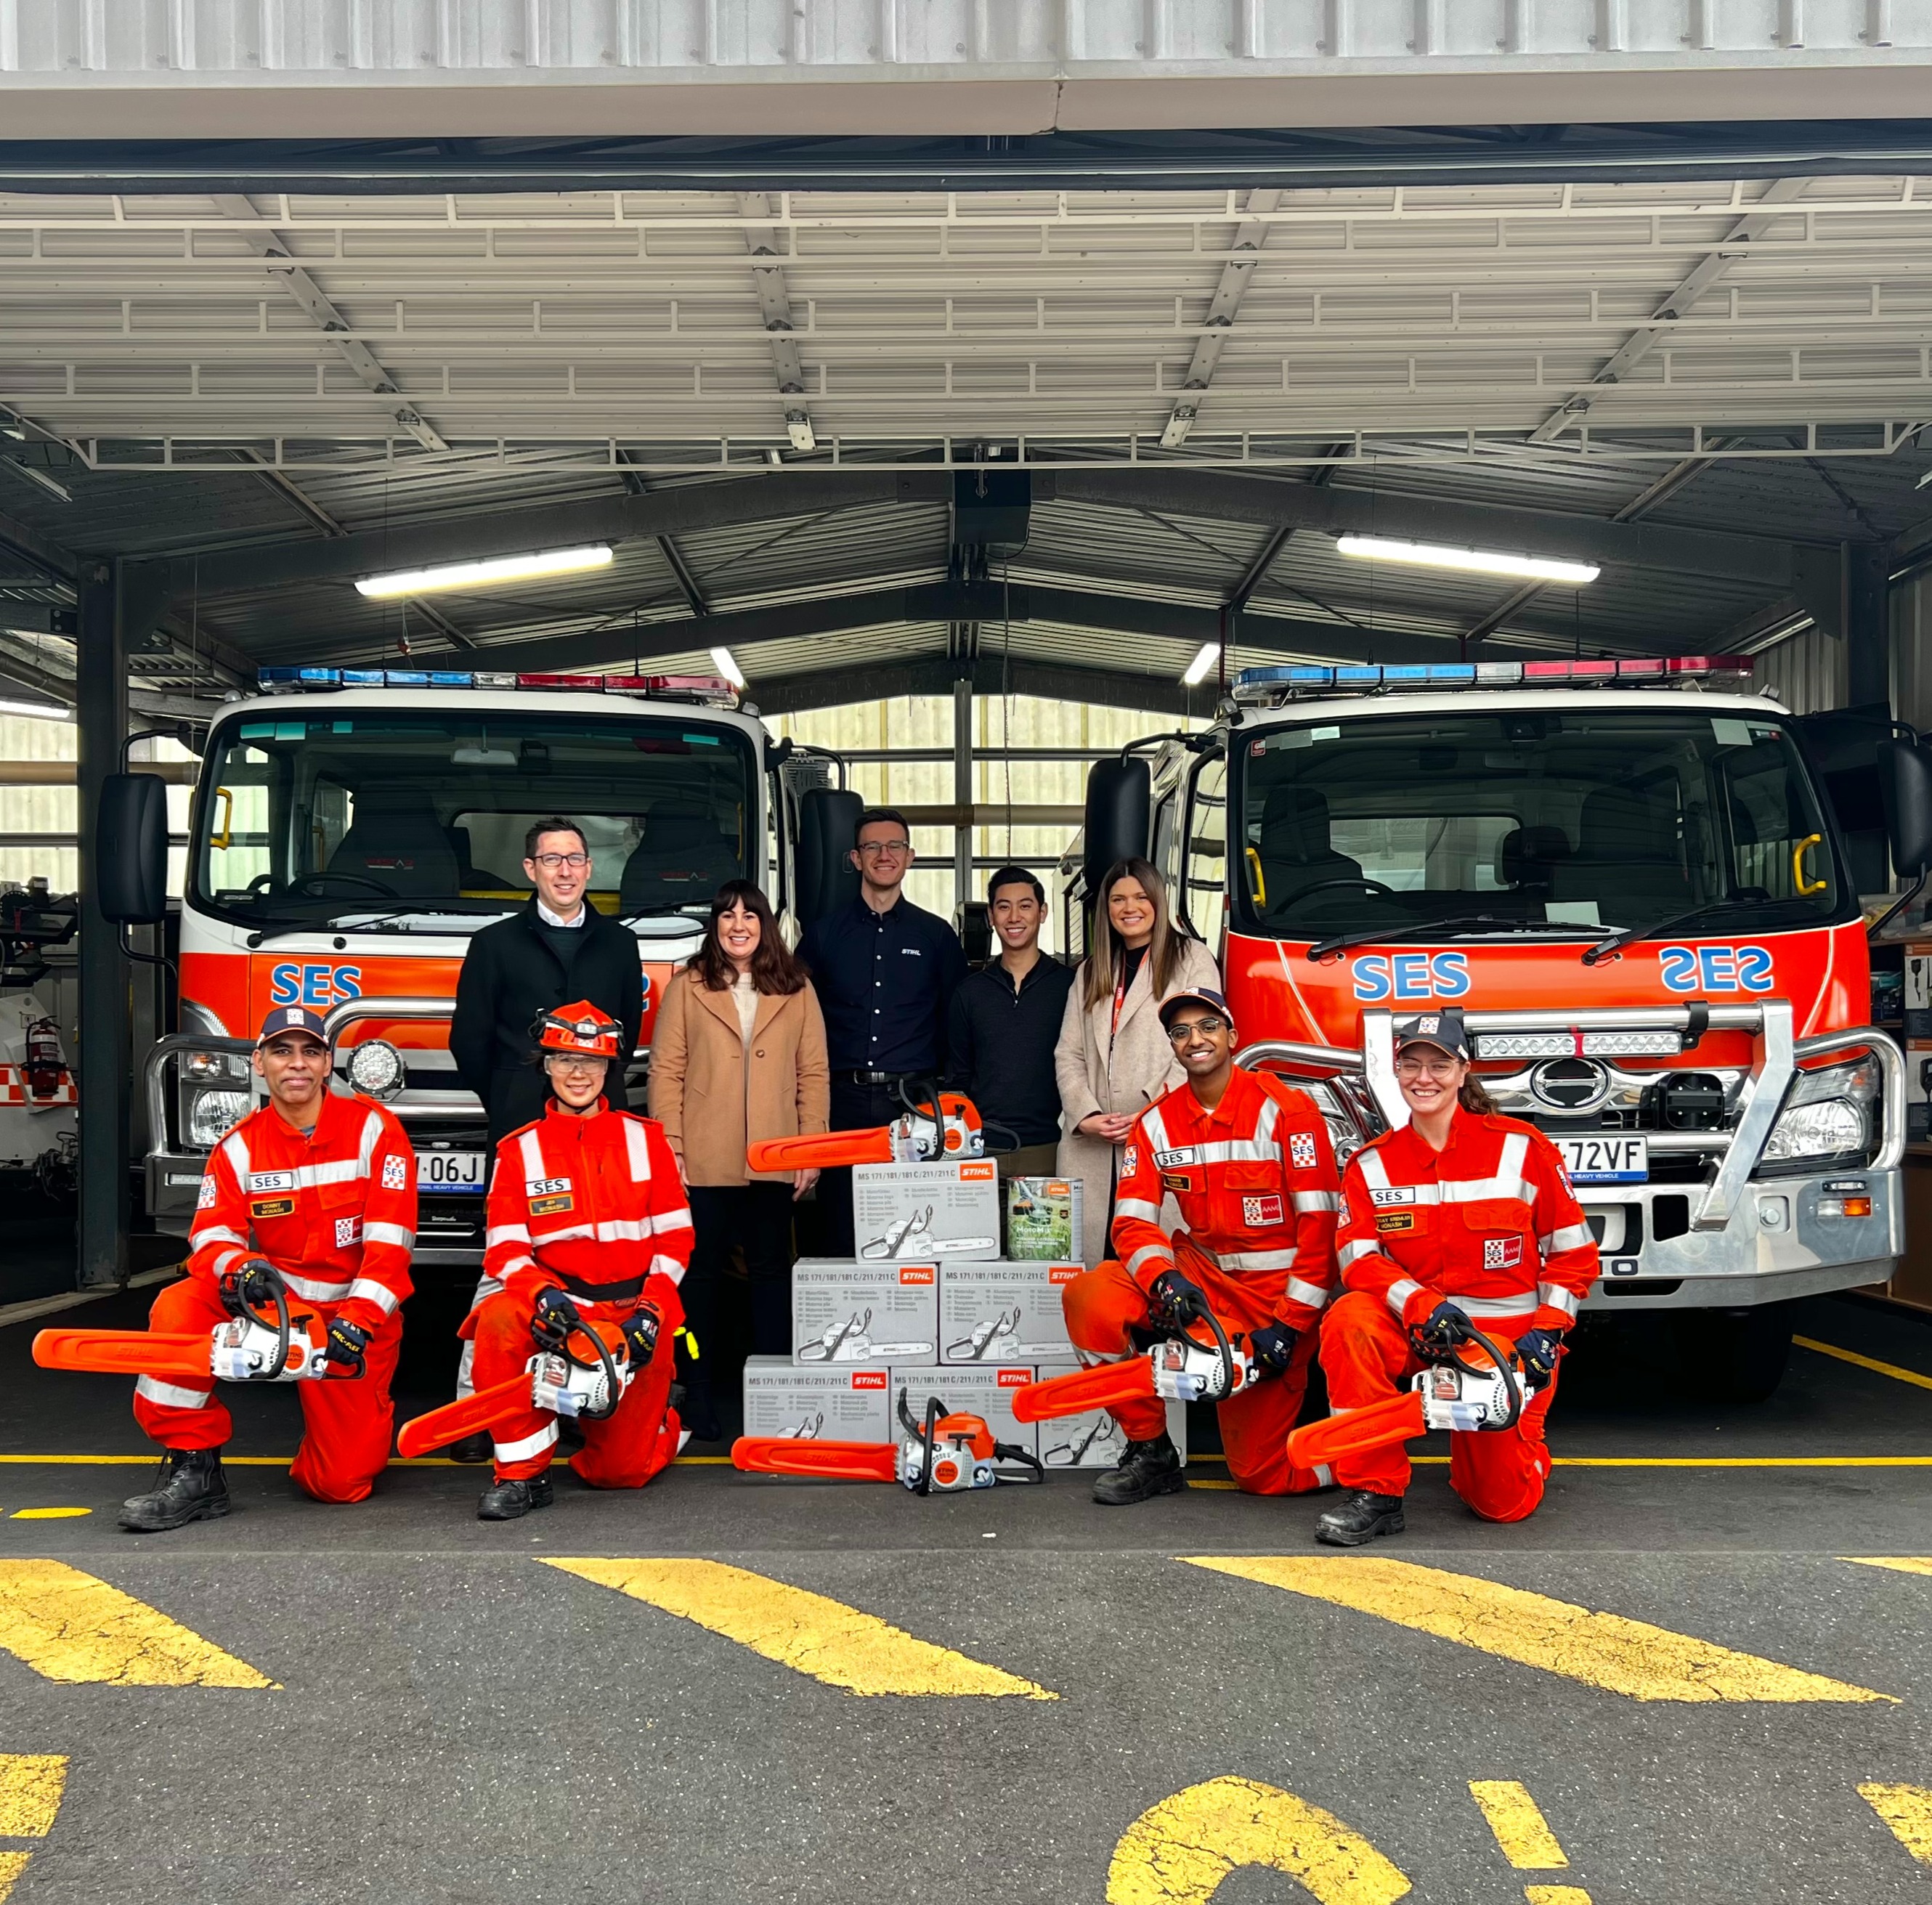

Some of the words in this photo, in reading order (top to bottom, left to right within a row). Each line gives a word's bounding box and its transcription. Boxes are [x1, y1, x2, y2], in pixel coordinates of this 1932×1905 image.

[1351, 951, 1472, 1002] SES
[271, 963, 362, 1006] SES
[1292, 1146, 1313, 1155] SES
[1568, 1141, 1641, 1170] 72VF
[1162, 1153, 1183, 1164] SES
[385, 1166, 404, 1177] SES
[431, 1156, 476, 1182] 06J
[255, 1176, 281, 1187] SES
[534, 1179, 564, 1194] SES
[201, 1187, 215, 1196] SES
[1376, 1191, 1403, 1202] SES
